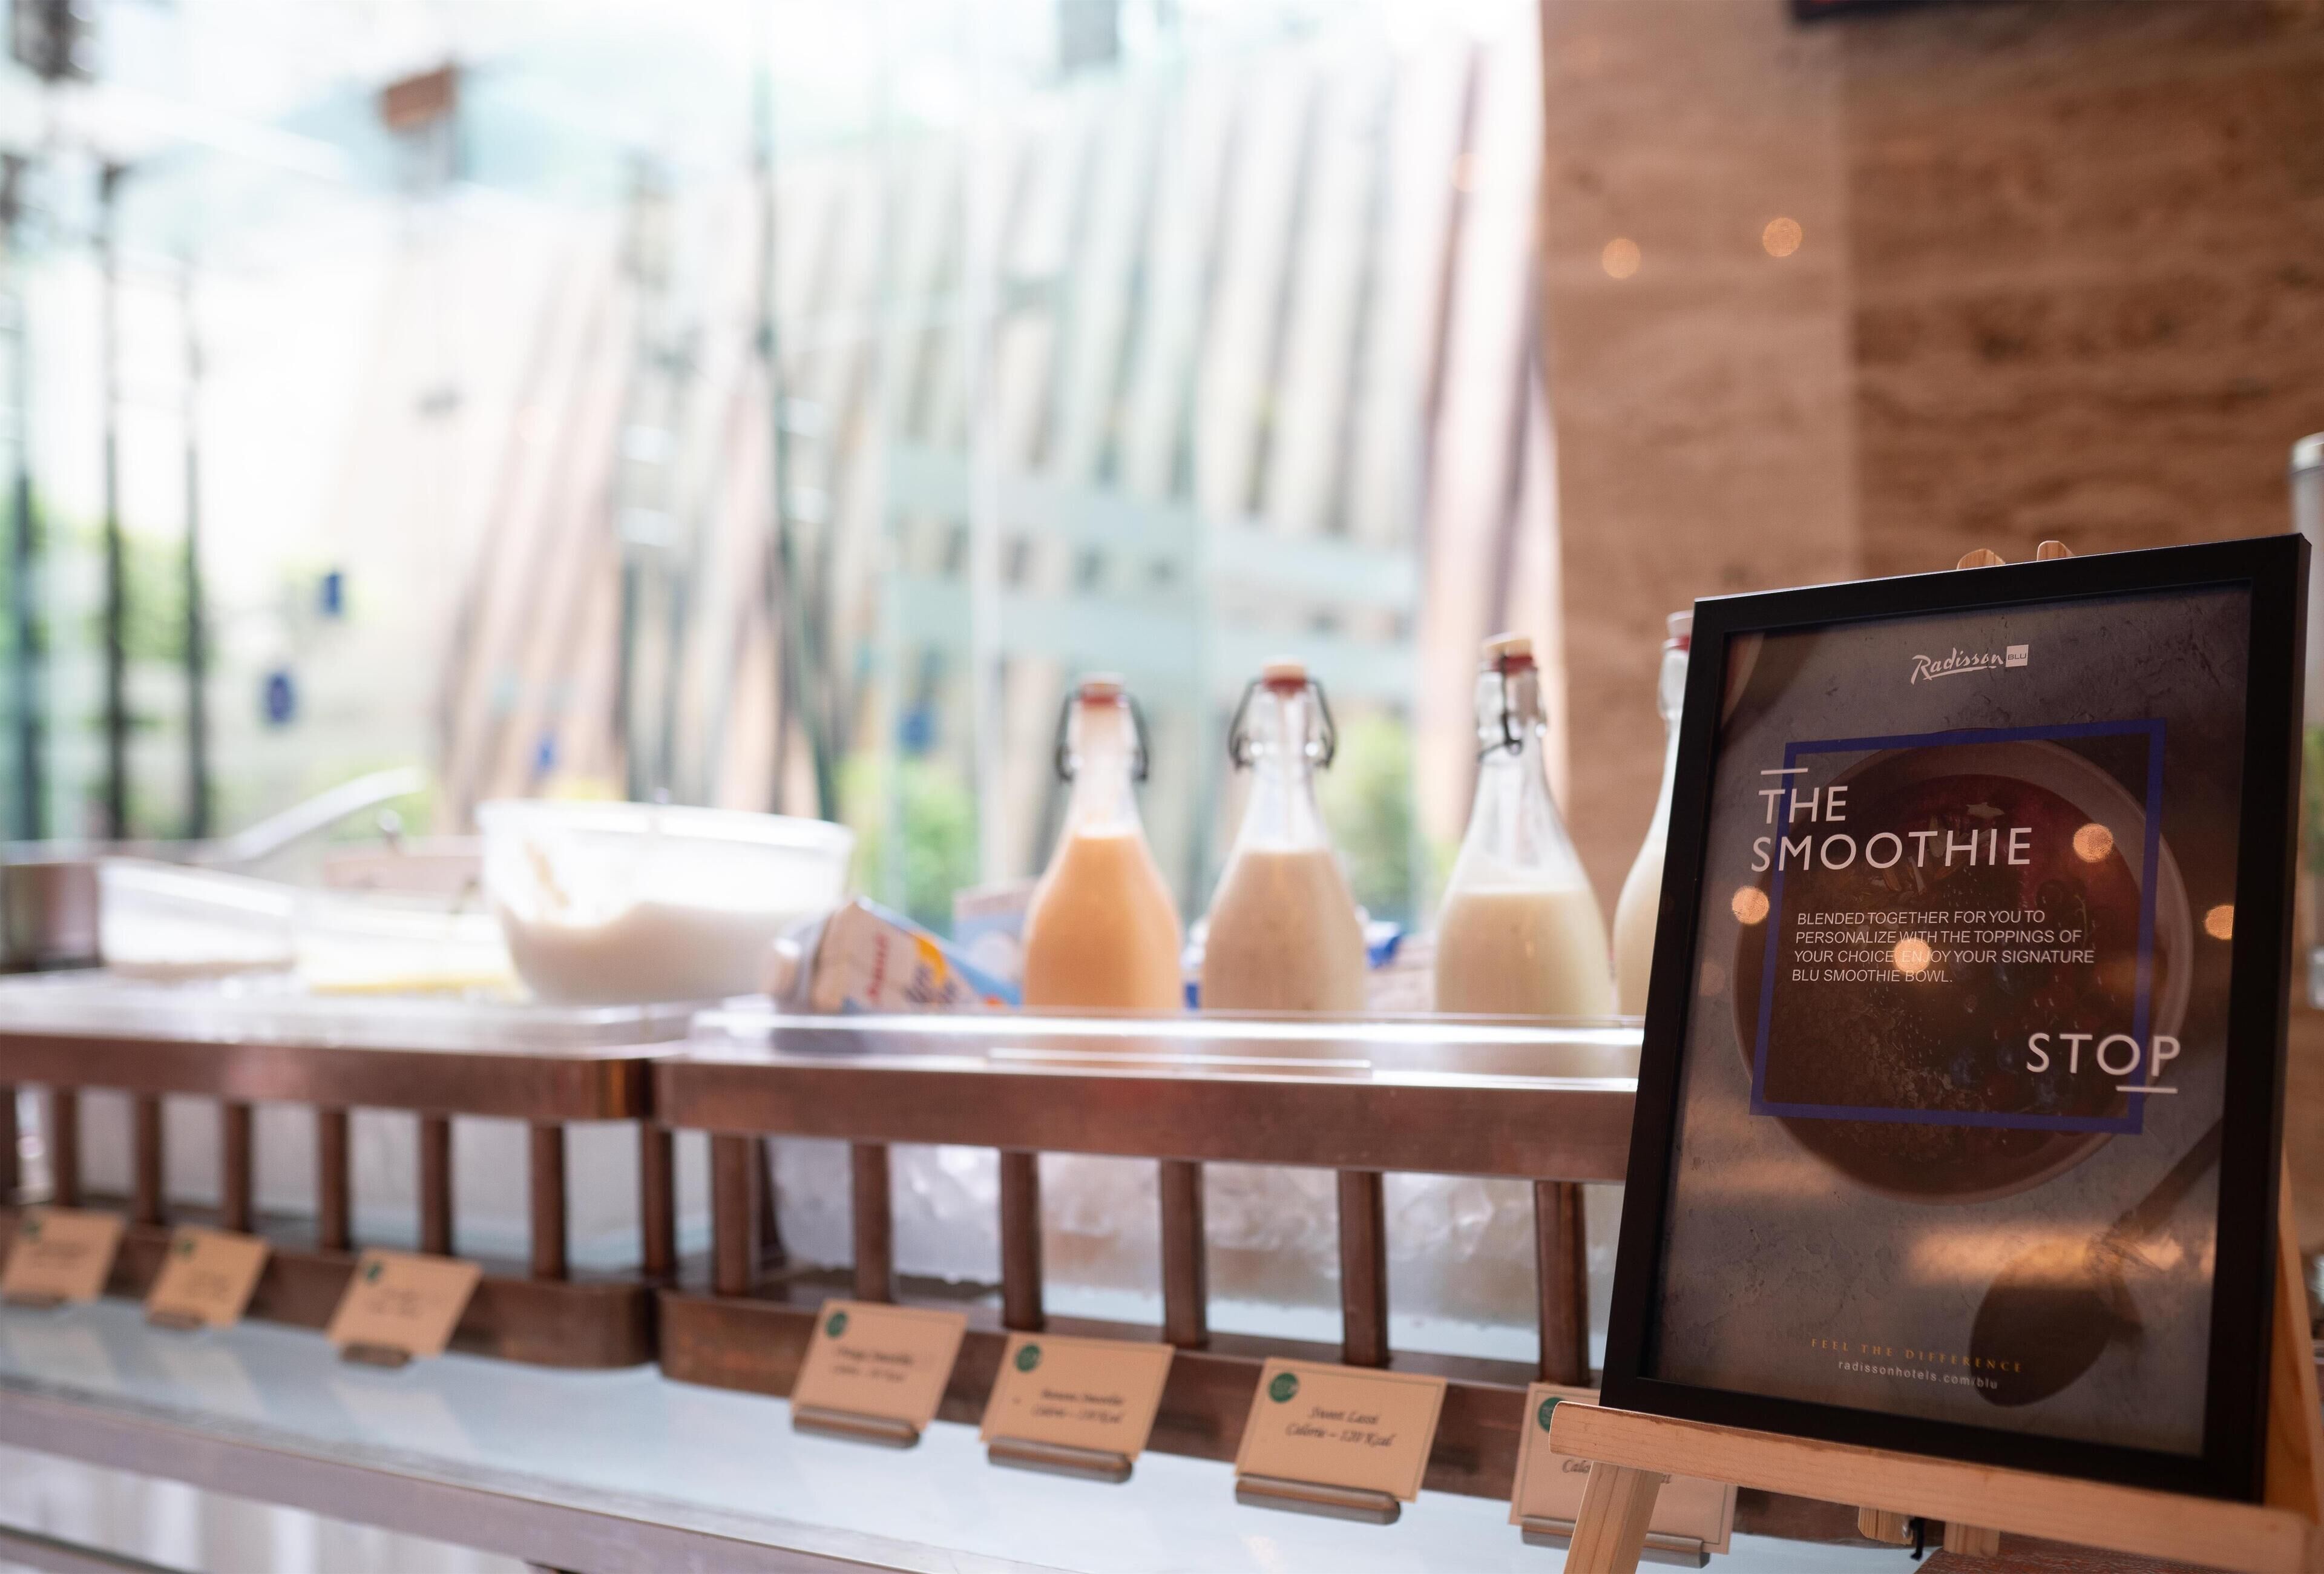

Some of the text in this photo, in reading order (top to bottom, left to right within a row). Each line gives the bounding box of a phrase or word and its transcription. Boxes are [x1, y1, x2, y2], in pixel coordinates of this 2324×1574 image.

[1911, 647, 2004, 685] Radisson
[1758, 786, 1848, 825] THE
[1751, 828, 2032, 873] SMOOTHIE
[1797, 910, 2046, 925] BLENDED TOGETHER FOR YOU TO
[1796, 929, 2083, 944] PERSONALIZE WITH THE TOPPINGS OF
[1794, 950, 1834, 963] YOUR
[1902, 950, 1952, 963] ENJOY
[1954, 950, 1997, 963] YOUR
[2001, 949, 2095, 963] SIGNATURE
[1791, 969, 1953, 983] BLU SMOOTHIE BOWL.
[2026, 1032, 2181, 1077] STOP
[1811, 1338, 2022, 1373] FEEL THE DIFFERENCE
[1838, 1360, 1998, 1389] radissonhotels.com/blu
